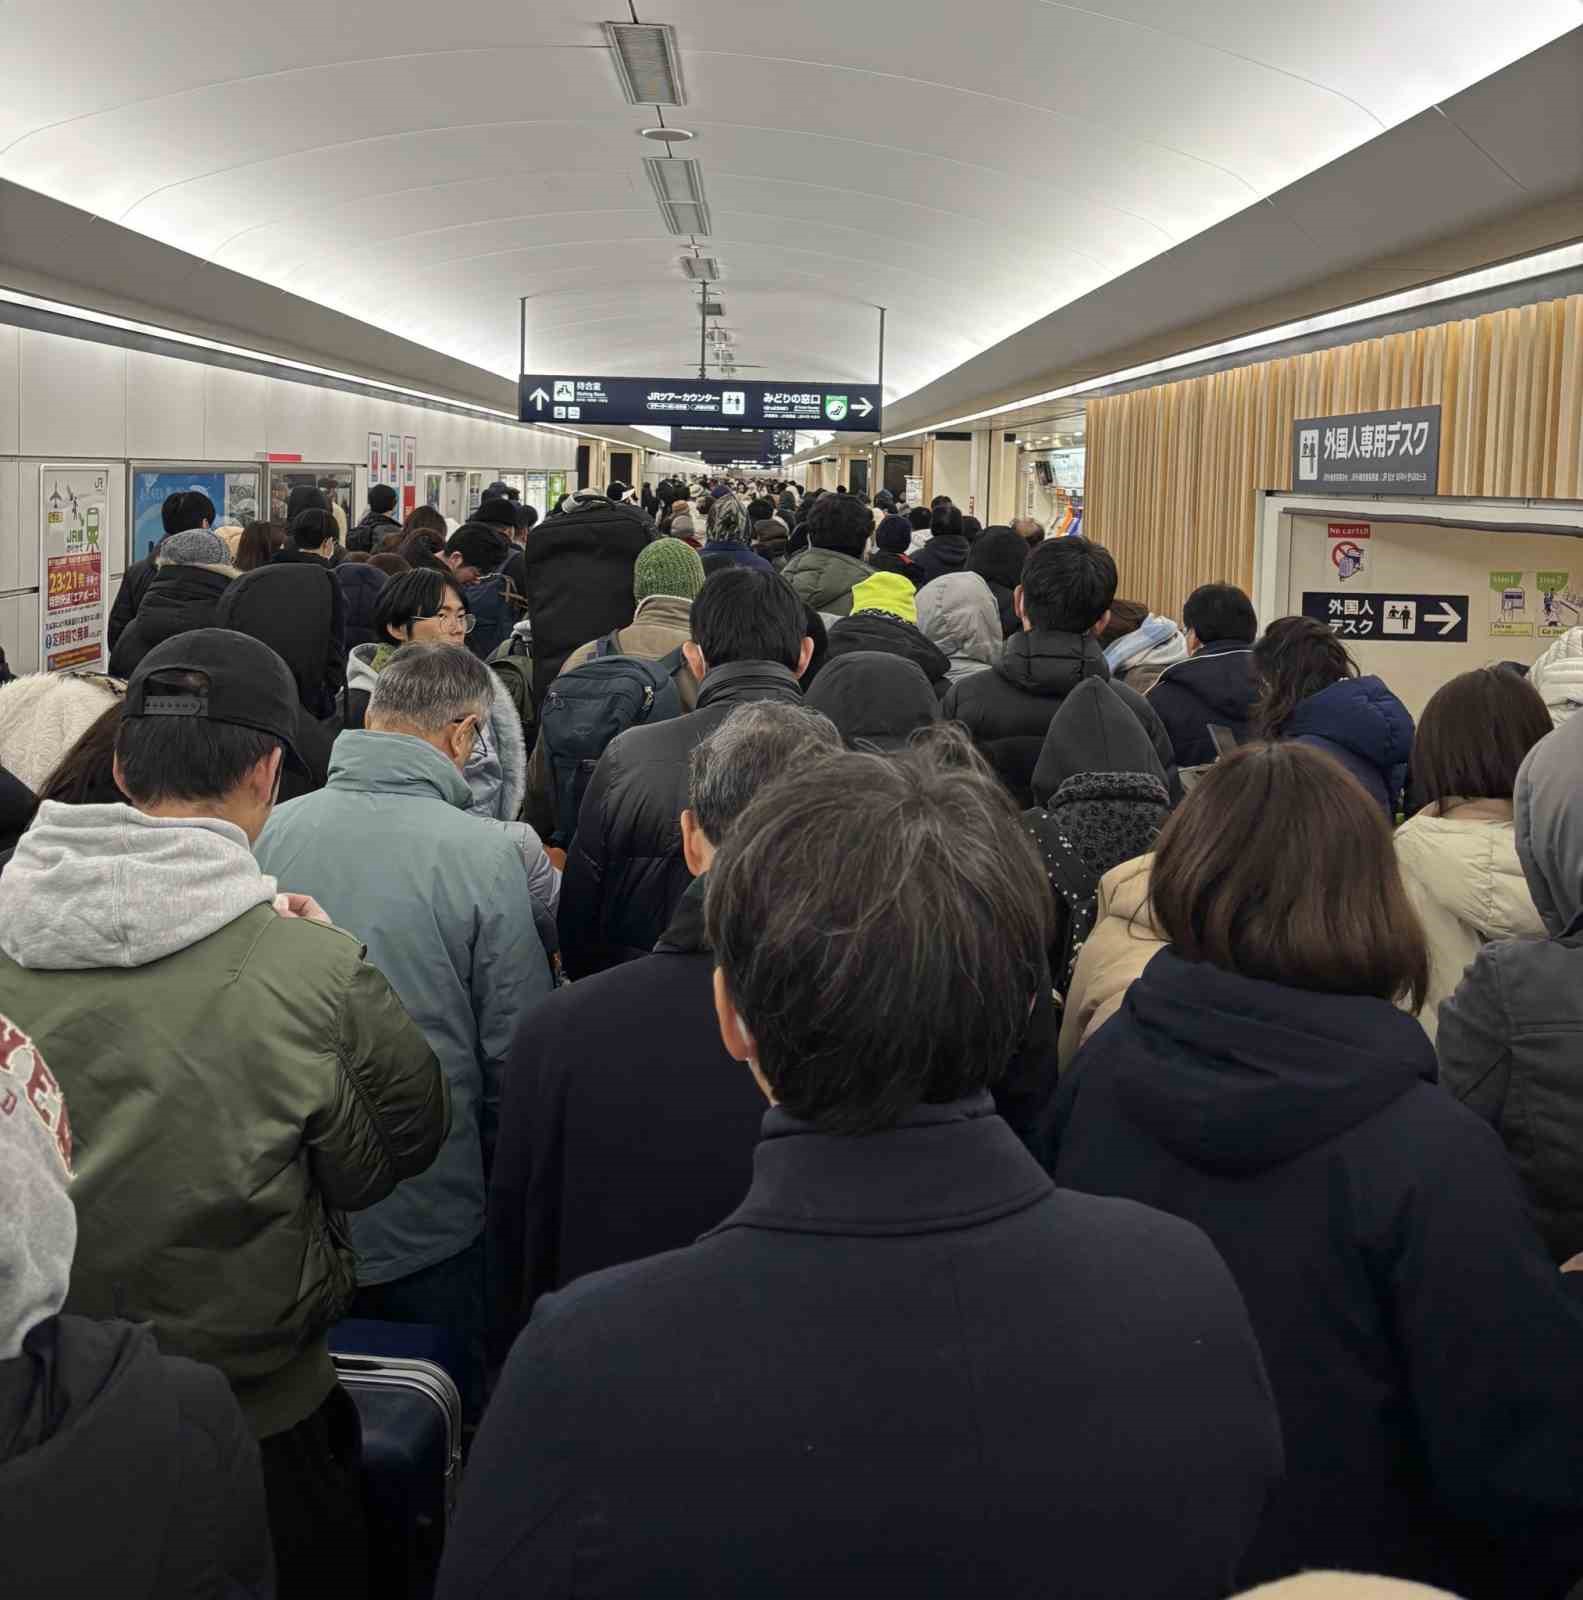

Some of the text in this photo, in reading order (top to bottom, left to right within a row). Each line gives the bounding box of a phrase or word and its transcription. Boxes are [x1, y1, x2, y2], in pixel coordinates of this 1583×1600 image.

[647, 391, 720, 402] JRツアーカウンター
[763, 392, 821, 405] みどりの窓口
[1324, 420, 1429, 460] 外国人専用デスク
[1328, 599, 1374, 615] 外国人
